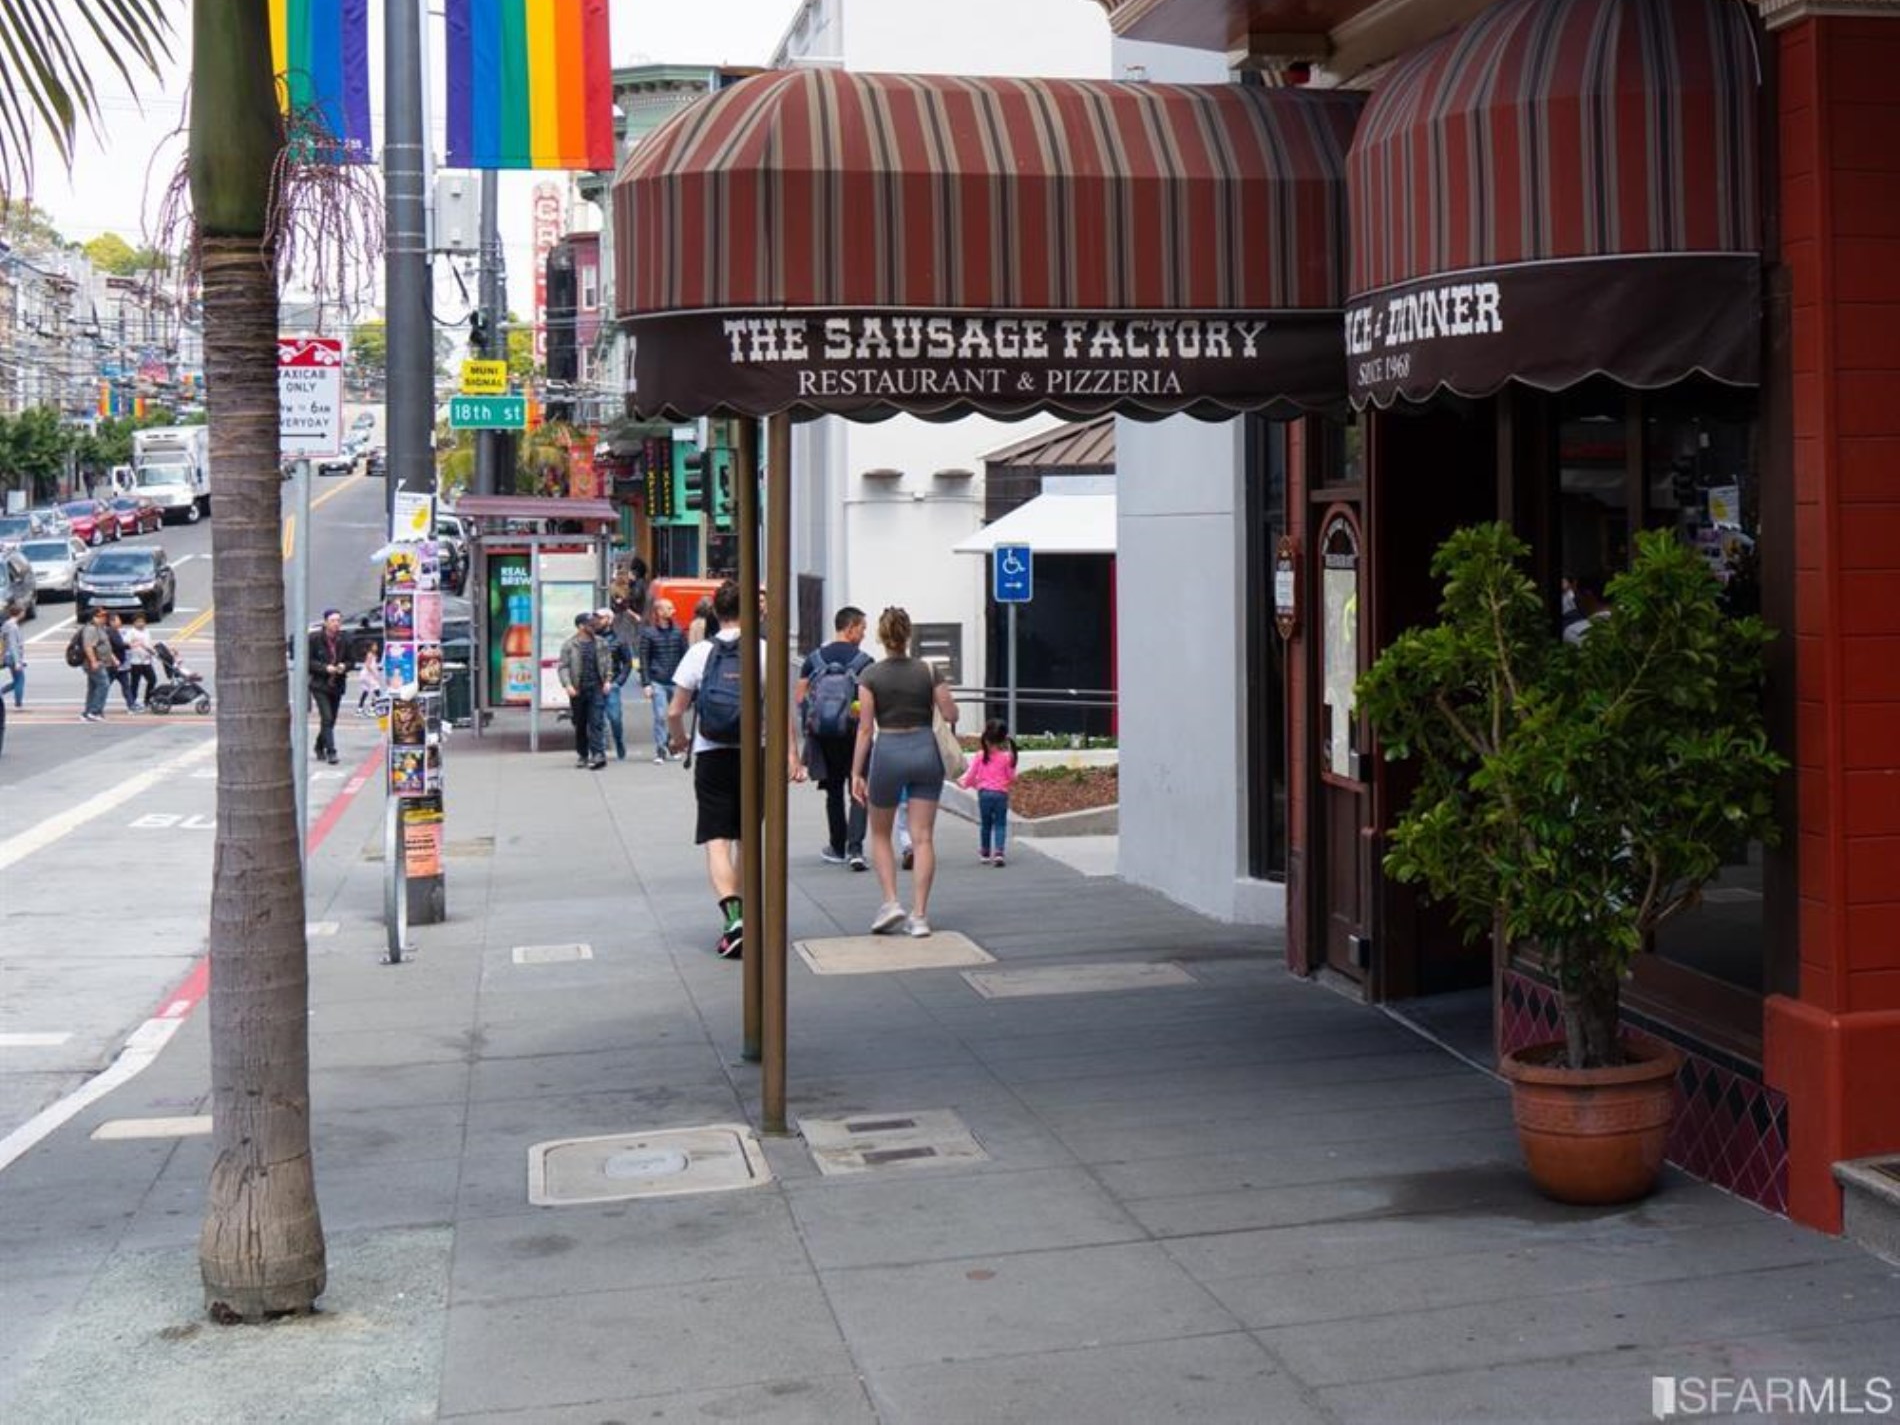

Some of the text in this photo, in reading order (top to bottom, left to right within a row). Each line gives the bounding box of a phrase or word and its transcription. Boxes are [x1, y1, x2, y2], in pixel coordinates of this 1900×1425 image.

[1384, 282, 1503, 347] DINNER
[723, 317, 1268, 363] THE SAUSAGE FACTORY
[280, 369, 326, 380] AXICAB
[470, 366, 498, 375] MUNI
[1357, 352, 1411, 386] SINCE 1968
[286, 382, 317, 393] ONLY
[465, 378, 502, 388] SIGNAL
[797, 368, 1183, 396] RESTAURANT & PIZZERIA
[455, 404, 521, 421] 18th st
[280, 416, 330, 427] VERYDAY
[500, 566, 527, 576] REAL
